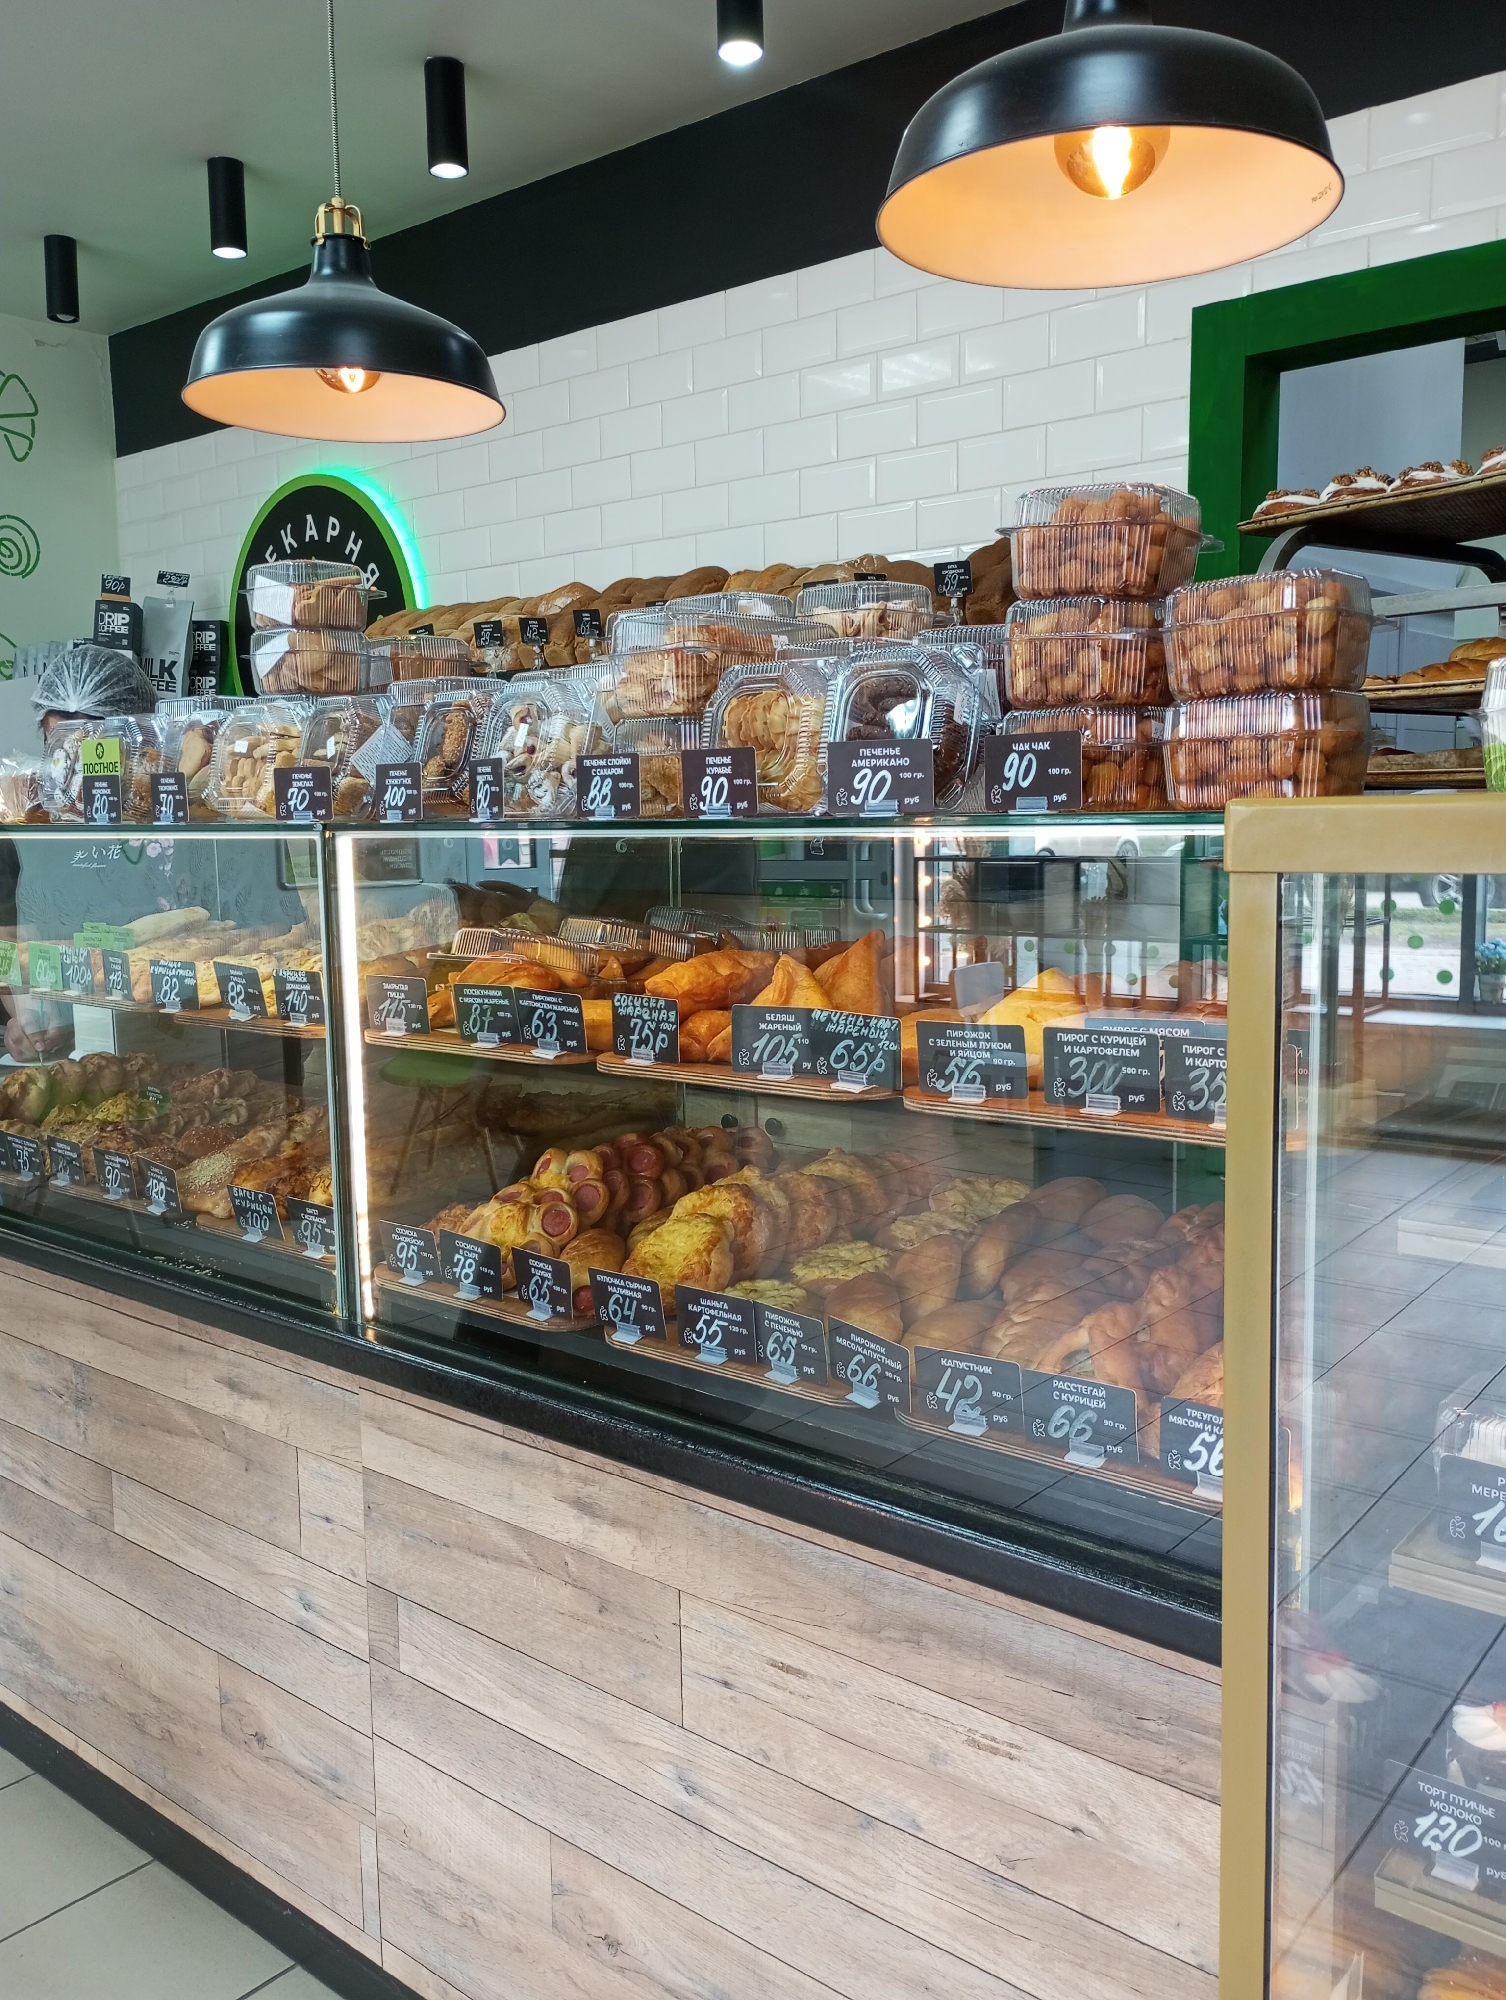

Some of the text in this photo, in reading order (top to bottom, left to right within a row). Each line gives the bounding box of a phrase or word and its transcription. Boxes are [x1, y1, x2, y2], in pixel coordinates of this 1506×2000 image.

[265, 514, 380, 590] ЕКАРНЯ
[98, 611, 129, 625] DRIP
[99, 625, 129, 634] COFFEE
[859, 747, 901, 756] ПЕЧЕНЬЕ
[1012, 741, 1051, 751] ЧАК ЧАК
[83, 762, 119, 775] ПОСТНОЕ
[851, 758, 910, 768] АМЕРИКАНО
[1002, 752, 1037, 791] 90
[700, 776, 729, 810] 90
[850, 768, 892, 805] 90
[160, 794, 173, 816] 70
[287, 788, 310, 812] 70
[383, 786, 406, 809] 100
[904, 796, 919, 805] руб
[1053, 793, 1068, 802] руб
[622, 803, 631, 811] руб
[737, 803, 748, 811] руб
[161, 976, 181, 1001] 82
[228, 982, 245, 1006] 82
[285, 990, 308, 1012] 140
[379, 999, 411, 1022] 115
[469, 1004, 494, 1034] 87
[766, 1014, 795, 1022] БЕЛЯШ
[531, 1009, 558, 1041] 63
[759, 1022, 802, 1032] ЖАРЕНЫЙ
[946, 1030, 991, 1040] ПИРОЖОК
[1056, 1033, 1147, 1048] ПИРОГ С КУРИЦЕЙ
[752, 1032, 803, 1065] 105
[935, 1039, 978, 1048] ЗЕЛЕНЫМ
[979, 1042, 1012, 1051] ЛУКОМ
[958, 1048, 991, 1059] ЯЙЦОМ
[1064, 1045, 1140, 1057] И КАРТОФЕЛЕМ
[1182, 1045, 1225, 1056] ПИРОГ С
[1121, 1066, 1150, 1076] 500 гр.
[1185, 1057, 1227, 1069] И КАРТО
[934, 1057, 986, 1092] 56
[995, 1082, 1012, 1092] руб
[1128, 1094, 1145, 1104] руб
[105, 1166, 120, 1188] 90
[247, 1211, 270, 1231] 100
[301, 1220, 322, 1244] 95
[455, 1240, 483, 1253] СОСИСКА
[396, 1242, 418, 1271] 95
[529, 1259, 553, 1272] СОСИСКА
[453, 1253, 476, 1284] 78
[529, 1276, 554, 1304] 65
[596, 1275, 651, 1293] БУЛОЧКА СЫРНАЯ
[607, 1286, 642, 1300] НАЛИВНАЯ
[608, 1294, 637, 1325] 64
[699, 1297, 729, 1310] ШАНЬГА
[687, 1304, 742, 1322] КАРТОФЕЛЬНАЯ
[765, 1311, 801, 1329] ПИРОЖОК
[645, 1324, 656, 1332] руб
[693, 1314, 729, 1347] 55
[764, 1320, 804, 1338] С ПЕЧЕНЬЮ
[808, 1346, 818, 1354] гр.
[850, 1332, 886, 1355] ПИРОЖОК
[836, 1335, 902, 1371] МЯСО/КАПУСТНЫЙ
[803, 1365, 815, 1375] руб
[846, 1354, 882, 1391] 66
[940, 1357, 993, 1375] КАПУСТНИК
[893, 1374, 903, 1383] гр.
[935, 1367, 983, 1415] 42
[991, 1390, 1013, 1401] 90 гр.
[1052, 1379, 1106, 1398] РАССТЕГАЙ
[887, 1394, 900, 1403] руб
[1053, 1391, 1106, 1410] С КУРИЦЕЙ
[993, 1414, 1008, 1423] руб
[1047, 1404, 1099, 1443] 66
[1103, 1419, 1127, 1430] 90 гр.
[1168, 1414, 1212, 1432] МЯСОМ И
[1106, 1444, 1123, 1454] руб
[1418, 1781, 1496, 1819] ТОРТ ПТИЧЬЕ
[1430, 1799, 1482, 1826] МОЛОКО
[1413, 1811, 1483, 1857] 120
[1483, 1836, 1501, 1848] 100
